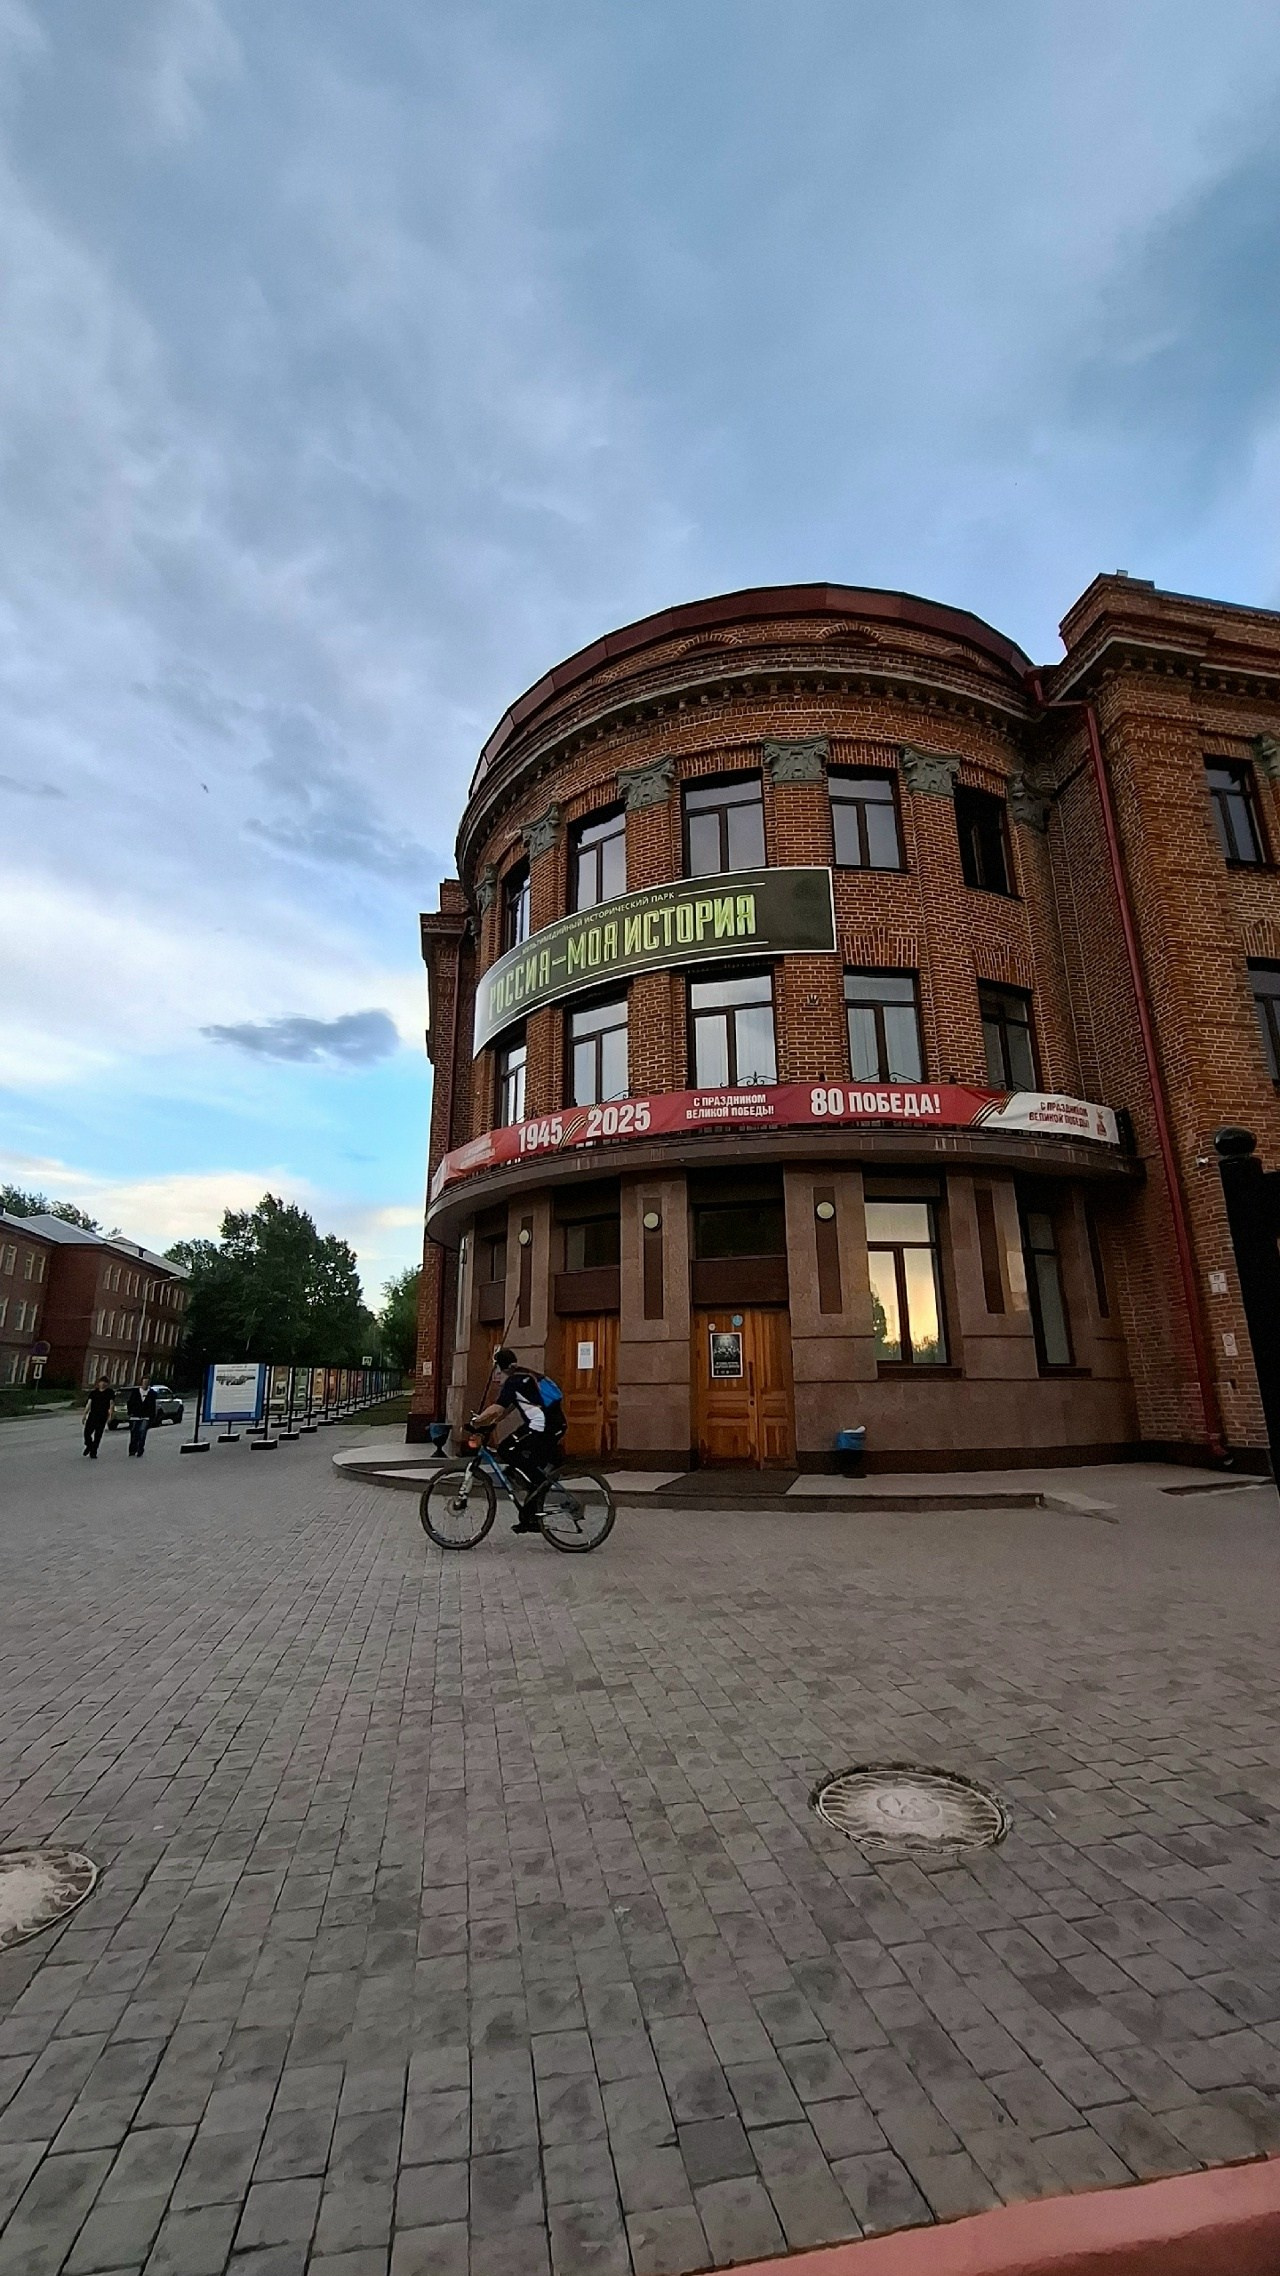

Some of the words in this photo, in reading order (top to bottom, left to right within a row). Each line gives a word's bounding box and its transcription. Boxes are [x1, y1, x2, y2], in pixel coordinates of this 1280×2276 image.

[584, 897, 649, 924] ИСТОРИЧЕСКИЙ
[651, 891, 675, 904] ПАРК
[624, 894, 756, 956] ИСТОРИЯ
[686, 1106, 729, 1120] ВЕЛИКОЙ
[731, 1104, 774, 1117] ПОБЕДЫ!
[693, 1098, 701, 1107] С
[701, 1094, 766, 1107] ПРАЗДНИКОМ
[811, 1088, 844, 1116] 80
[848, 1092, 941, 1117] ПОБЕДА!
[518, 1116, 563, 1153] 1945
[586, 1101, 650, 1138] 2025
